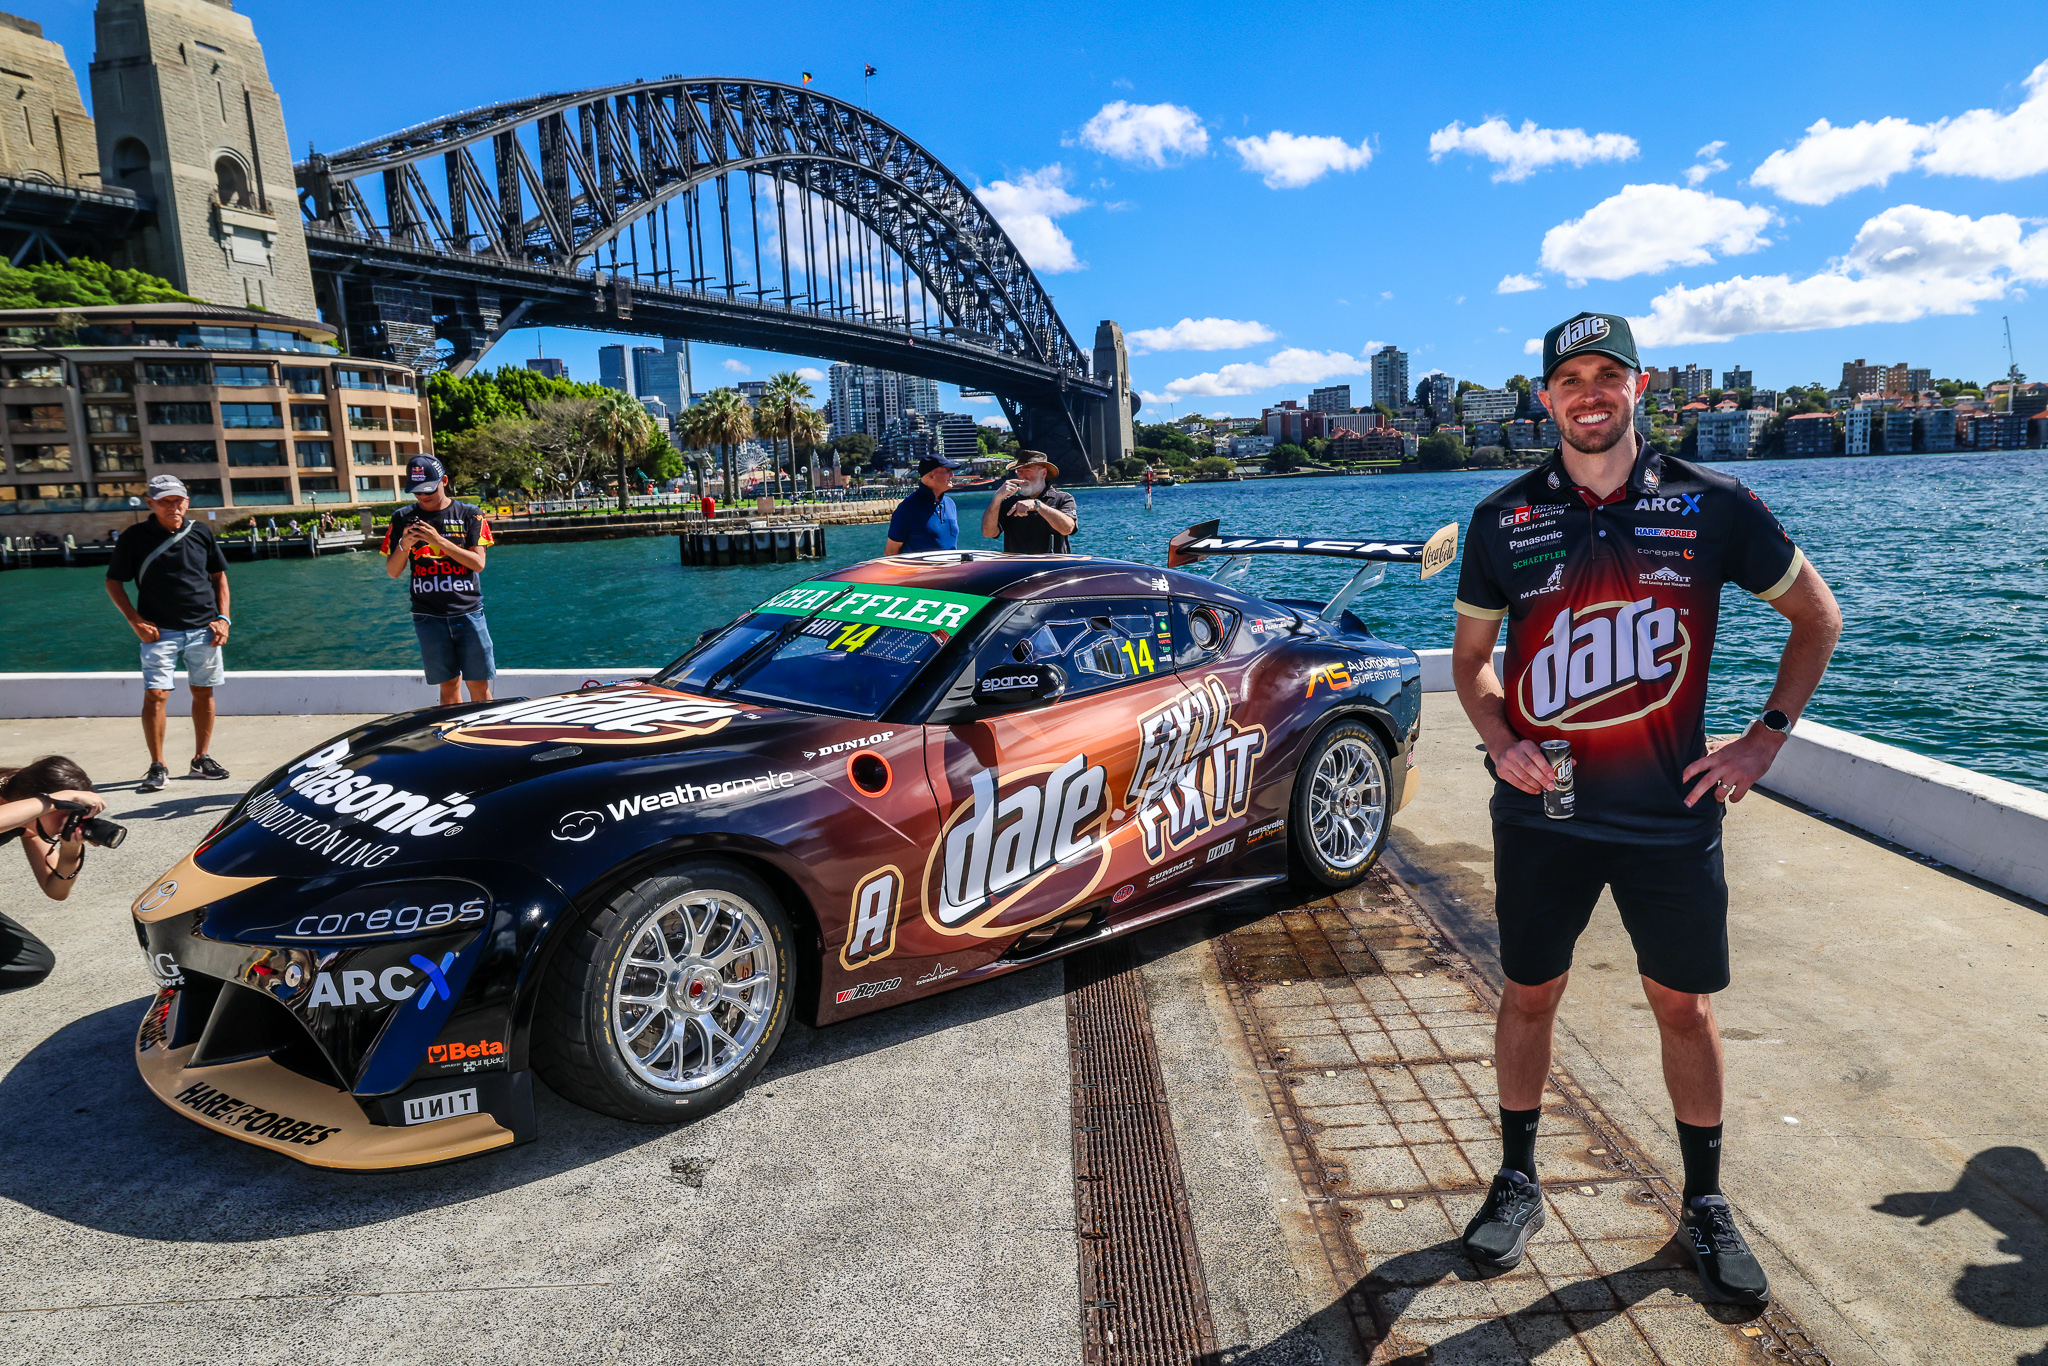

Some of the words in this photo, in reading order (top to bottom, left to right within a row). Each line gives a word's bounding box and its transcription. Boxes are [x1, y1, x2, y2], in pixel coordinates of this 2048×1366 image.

[1559, 315, 1605, 353] dare
[1532, 509, 1565, 520] Racing
[1513, 519, 1556, 534] Australia
[1190, 538, 1423, 555] MACK
[1508, 530, 1564, 550] Panasonic
[1512, 549, 1567, 570] SCHAEFFLER
[1637, 547, 1681, 558] coregas
[414, 560, 440, 577] Red
[1639, 572, 1692, 583] SUMMIT
[413, 575, 475, 594] Holden
[1520, 584, 1561, 600] MACK
[800, 617, 843, 637] Hill
[826, 622, 882, 653] 14
[1121, 638, 1156, 676] 14
[1346, 655, 1395, 674] Automotive
[1530, 595, 1677, 719] dare
[981, 674, 1039, 691] sparco
[1352, 668, 1402, 686] SUPERSTORE
[818, 731, 894, 757] DUNLOP
[1327, 726, 1375, 746] DUNLOP
[1212, 732, 1260, 813] IT
[606, 770, 795, 823] Weathermate
[1247, 818, 1285, 838] Lansvale
[938, 752, 1107, 926] dare
[1148, 857, 1196, 883] SUMMIT
[295, 899, 485, 936] coregas
[848, 872, 897, 960] A
[852, 976, 903, 999] Repco
[448, 1039, 504, 1061] Beta
